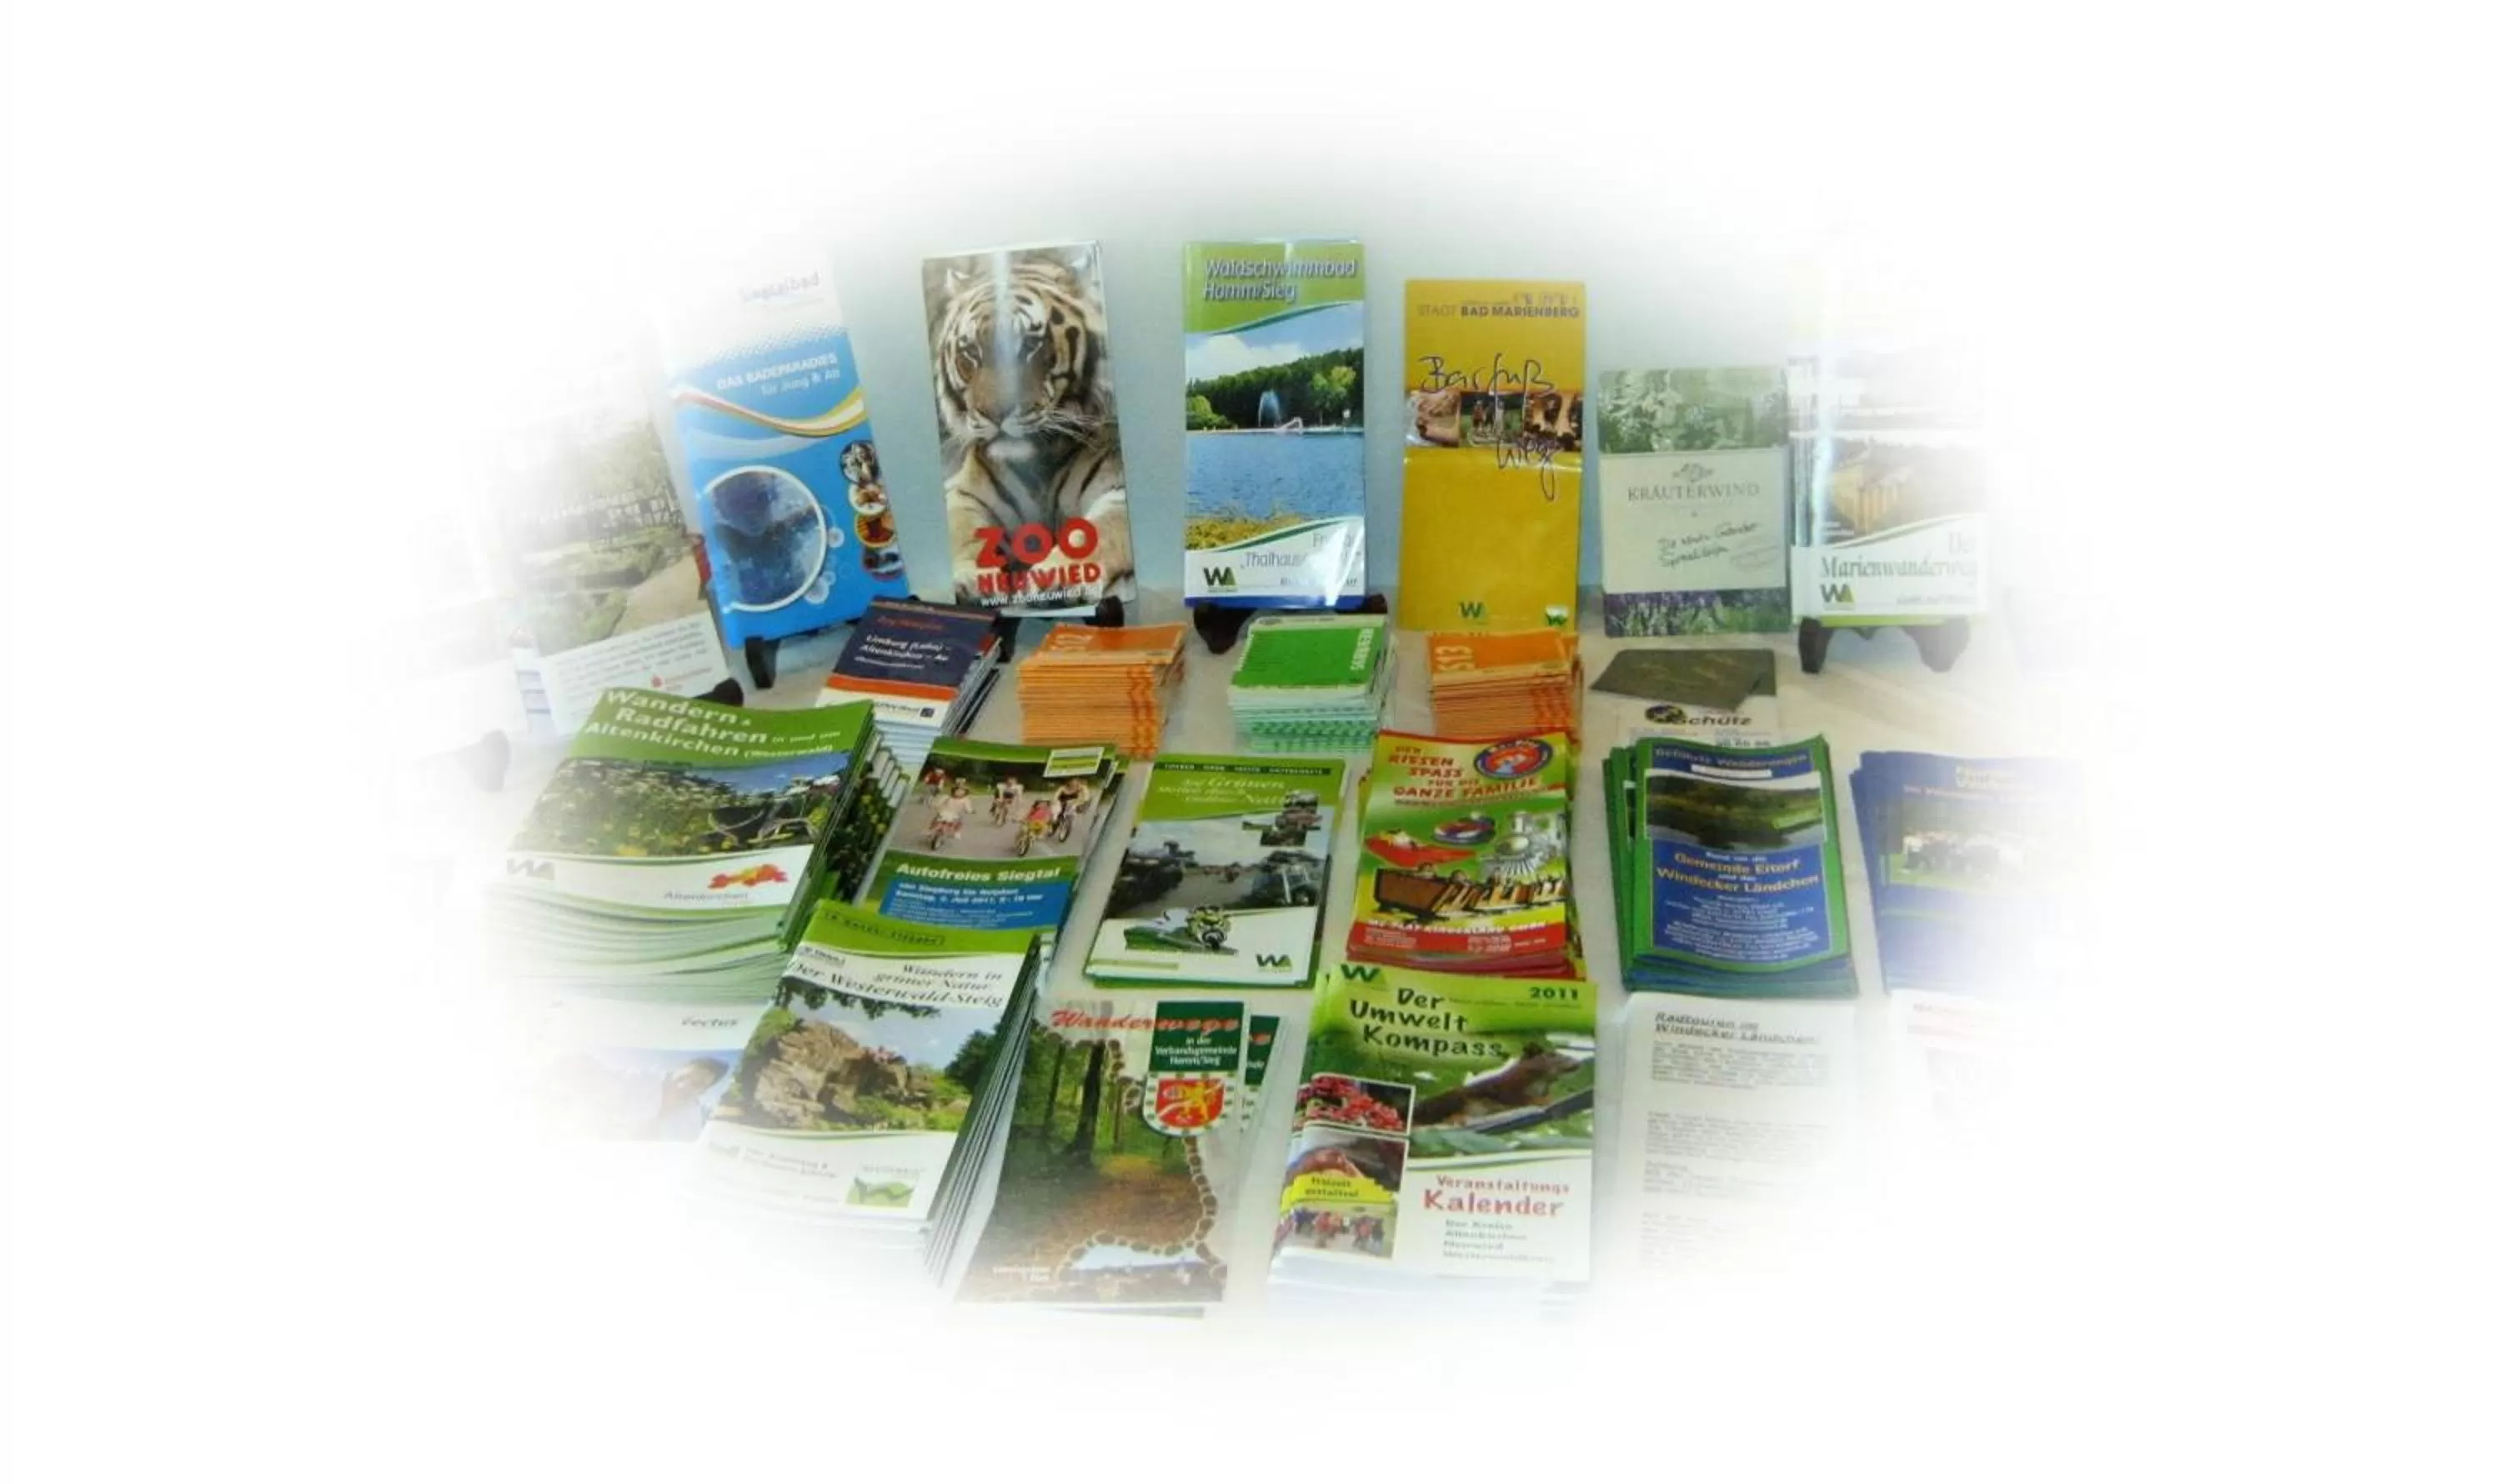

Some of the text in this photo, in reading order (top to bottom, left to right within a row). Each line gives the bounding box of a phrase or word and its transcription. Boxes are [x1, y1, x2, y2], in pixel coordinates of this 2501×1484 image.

[1461, 305, 1489, 318] BAD
[1491, 305, 1580, 318] MARIENBERG
[715, 352, 838, 390] DAS BADEPARADIES
[1628, 480, 1761, 502] KRÄUTERWIND
[974, 517, 1099, 568] ZOO
[976, 562, 1101, 596] NEUWIED
[605, 690, 737, 725] Wandern
[614, 708, 768, 745] Radfahren
[585, 722, 740, 758] Altenkirchen
[1388, 755, 1455, 766] RIESEN
[1408, 767, 1464, 778] SPASS
[1393, 777, 1541, 799] GANZE FAMILIE
[895, 863, 1061, 883] Autofreies Siegtal
[1673, 852, 1802, 875] Gemeinde Eitorf
[1656, 866, 1819, 893] Windecker Ländchen
[1397, 987, 1443, 1010] Der
[1528, 986, 1579, 1000] 2011
[1051, 1007, 1240, 1035] Wanderwege
[1350, 999, 1467, 1032] Umwelt
[1155, 1045, 1238, 1056] Verbandsgemeinde
[1436, 1173, 1571, 1195] Veranstaltungs
[1423, 1189, 1565, 1217] Kalender
